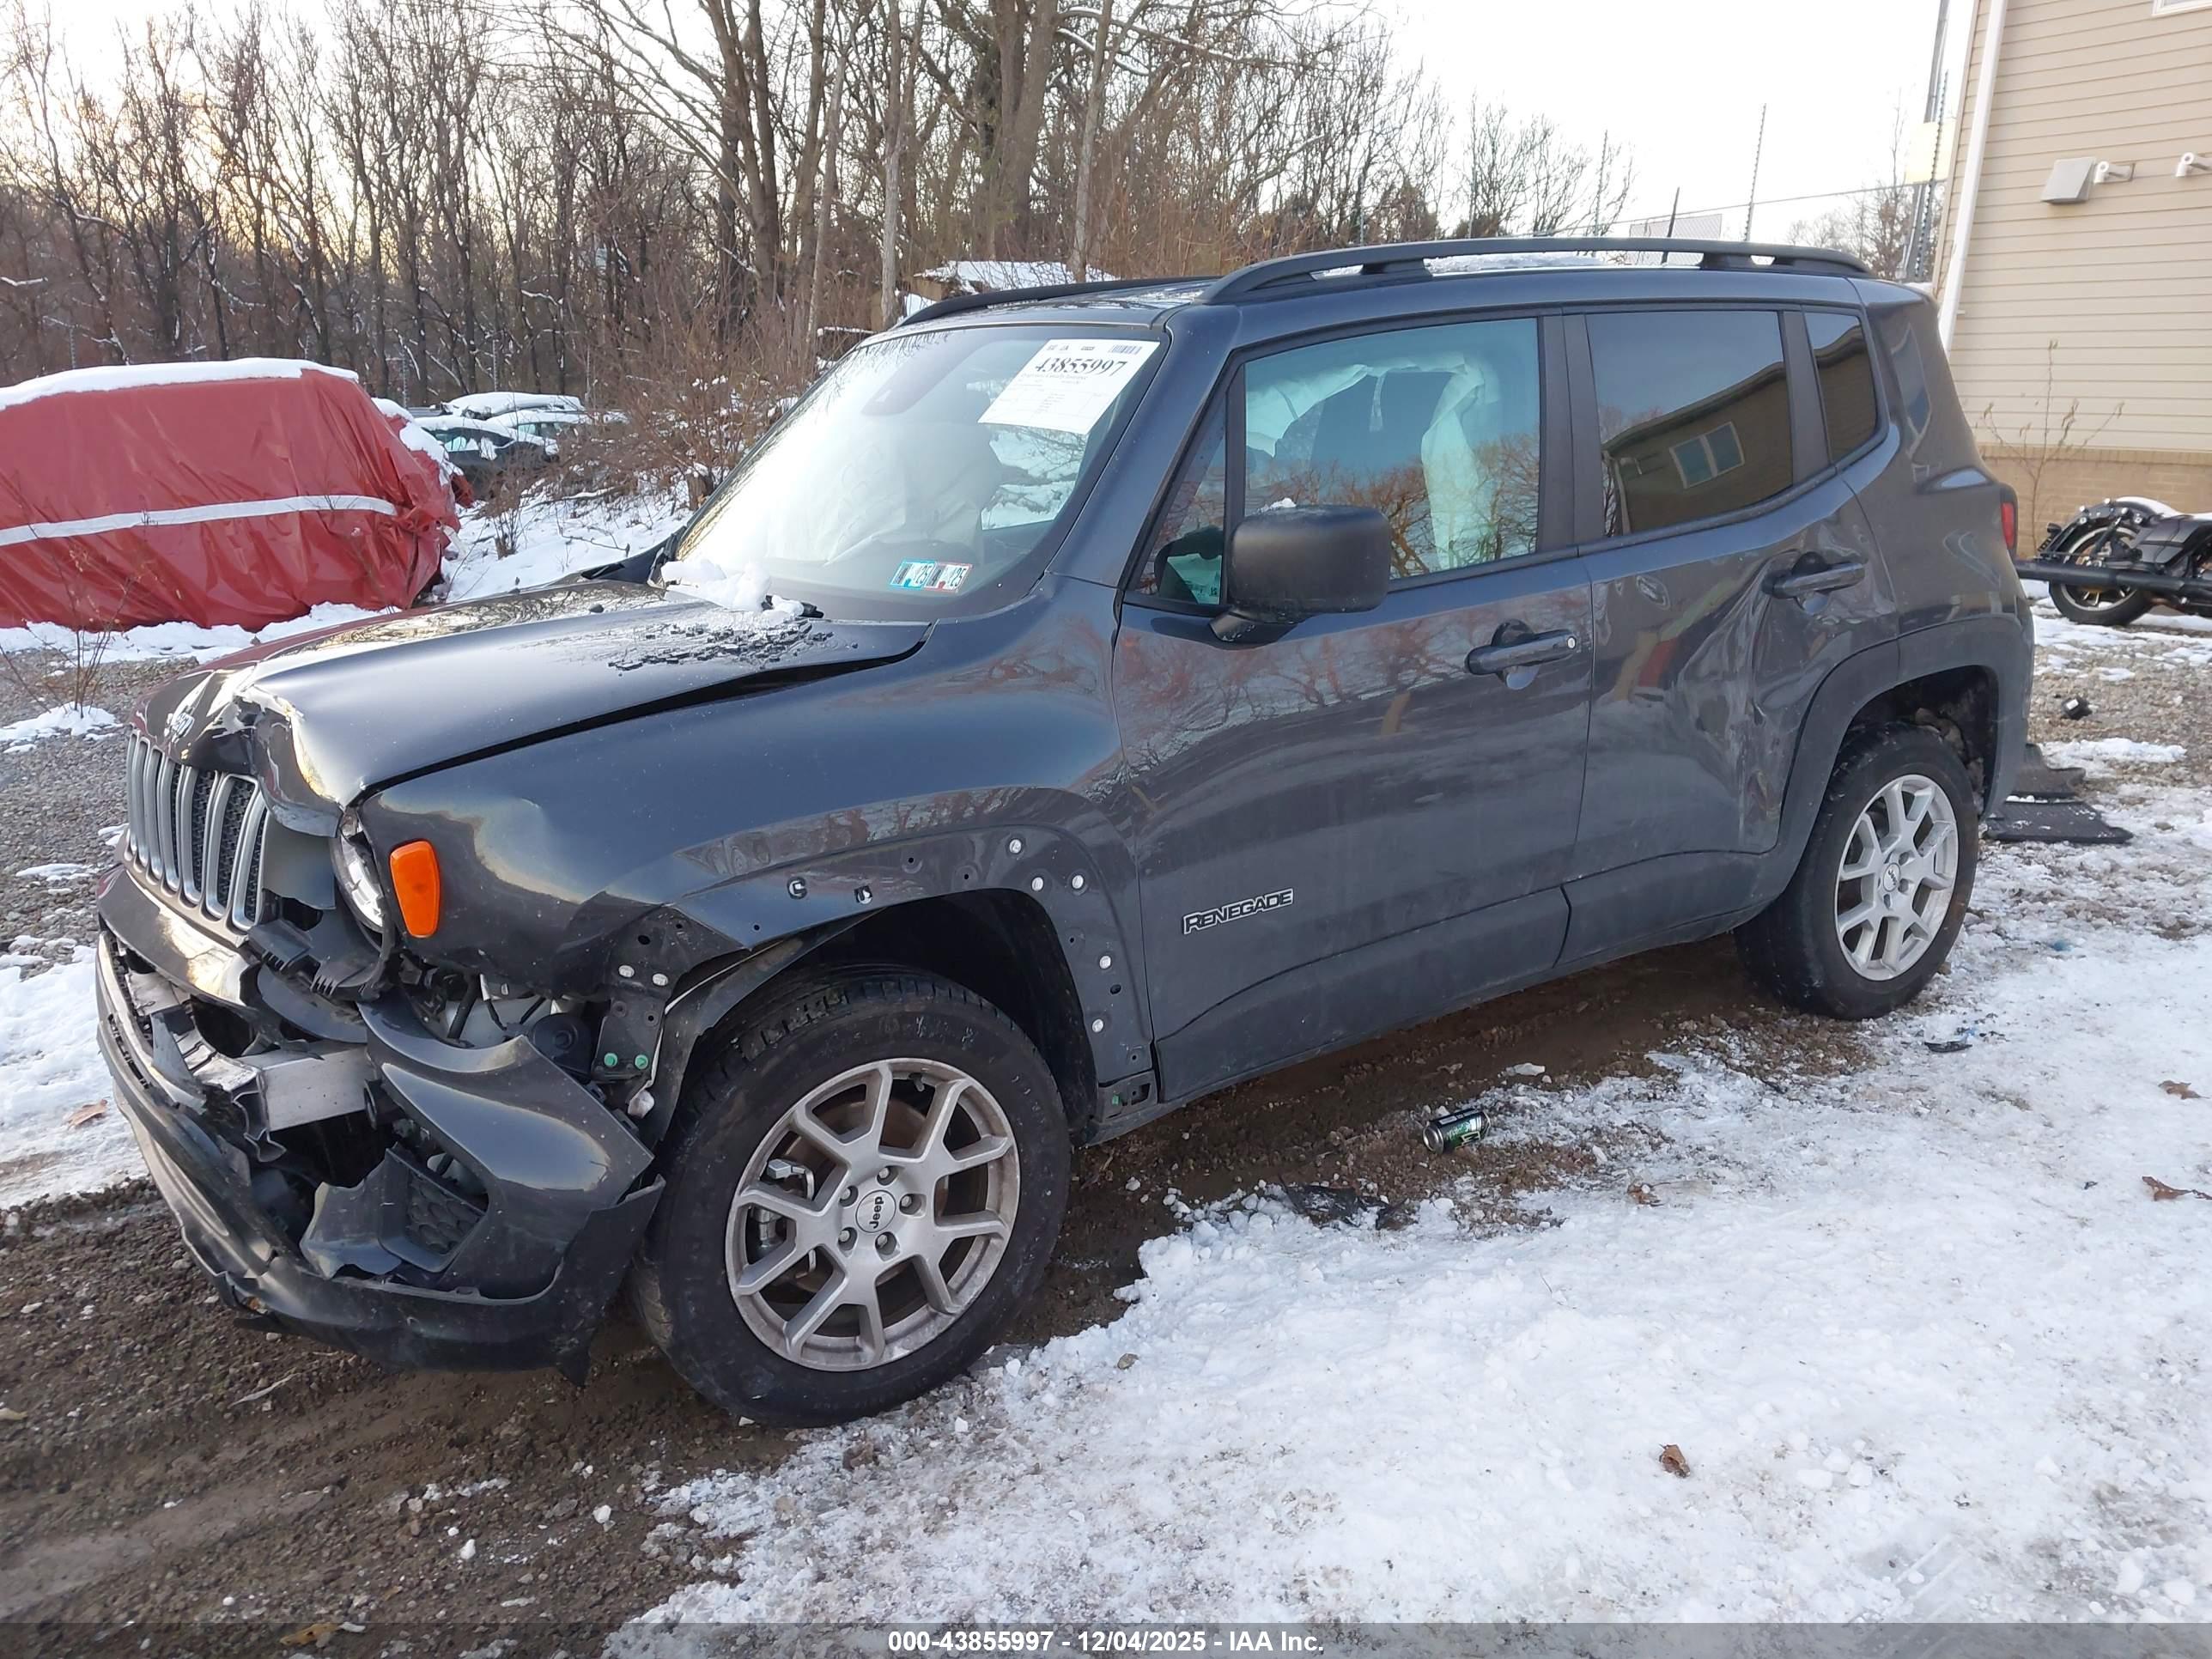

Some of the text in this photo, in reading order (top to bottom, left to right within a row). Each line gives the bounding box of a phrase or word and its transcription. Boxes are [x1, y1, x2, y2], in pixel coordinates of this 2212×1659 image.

[1035, 356, 1128, 377] 43855997
[914, 564, 933, 585] 25
[950, 567, 967, 587] 25
[1183, 888, 1294, 934] RENEGADE
[869, 1196, 884, 1230] Jeep
